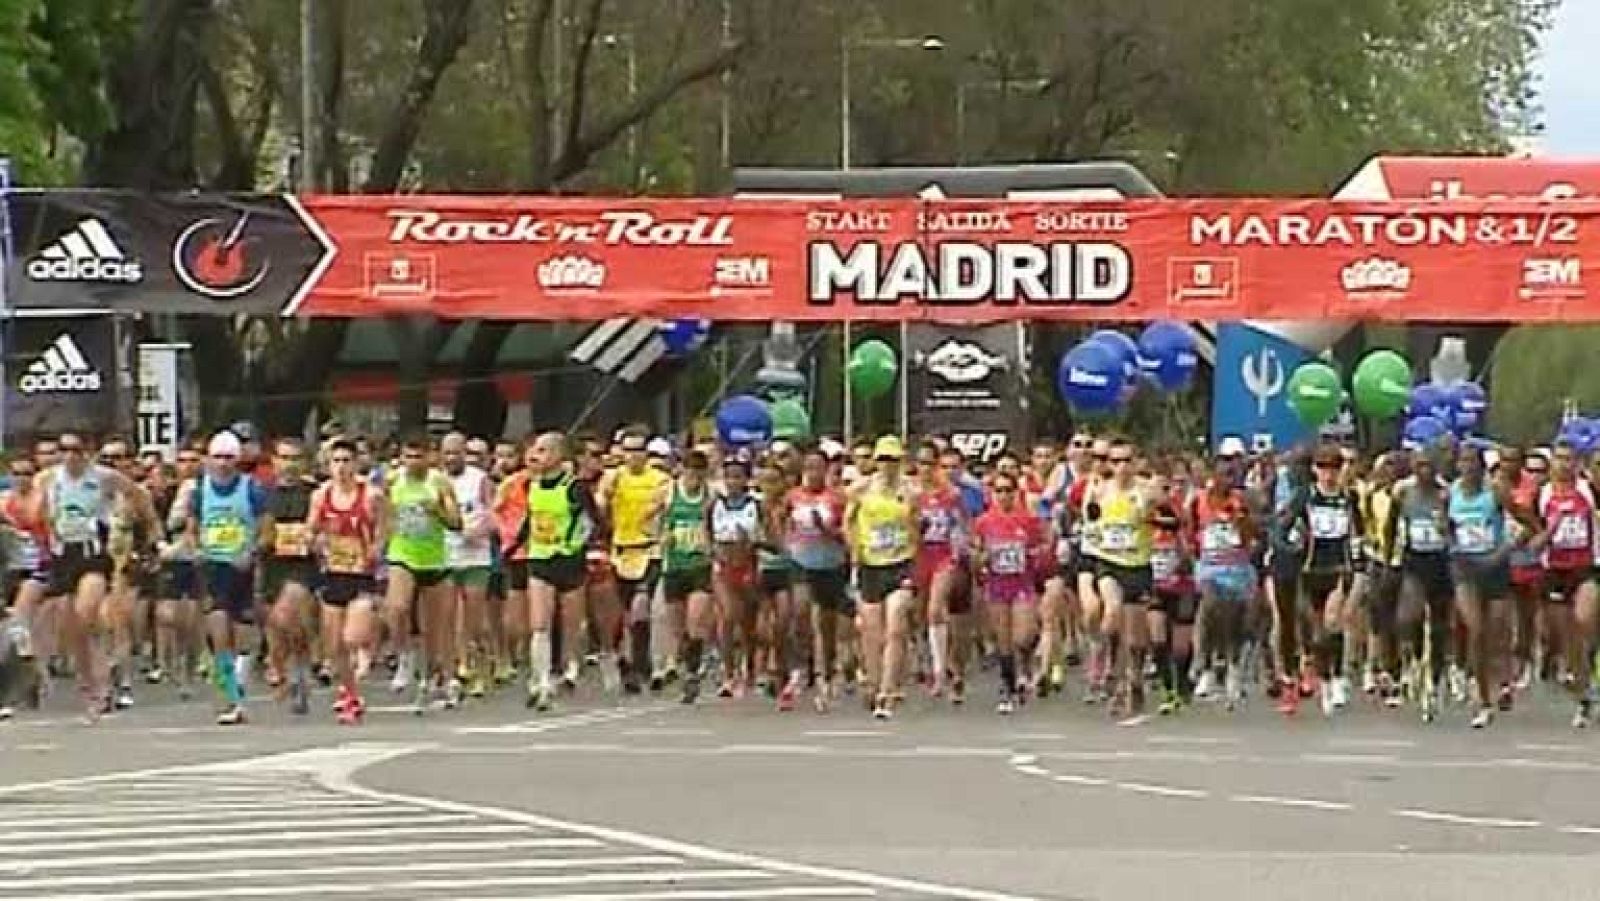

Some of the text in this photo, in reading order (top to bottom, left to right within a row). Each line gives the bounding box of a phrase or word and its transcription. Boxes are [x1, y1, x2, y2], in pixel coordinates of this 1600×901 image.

[387, 211, 550, 242] Rock
[601, 211, 734, 245] Roll
[806, 212, 893, 231] START
[1034, 212, 1129, 232] SORTIE
[1190, 208, 1466, 244] MARATÓN
[1510, 213, 1578, 247] 1/2
[28, 258, 142, 281] adidas
[808, 241, 1134, 304] MADRID
[19, 372, 101, 391] adidas
